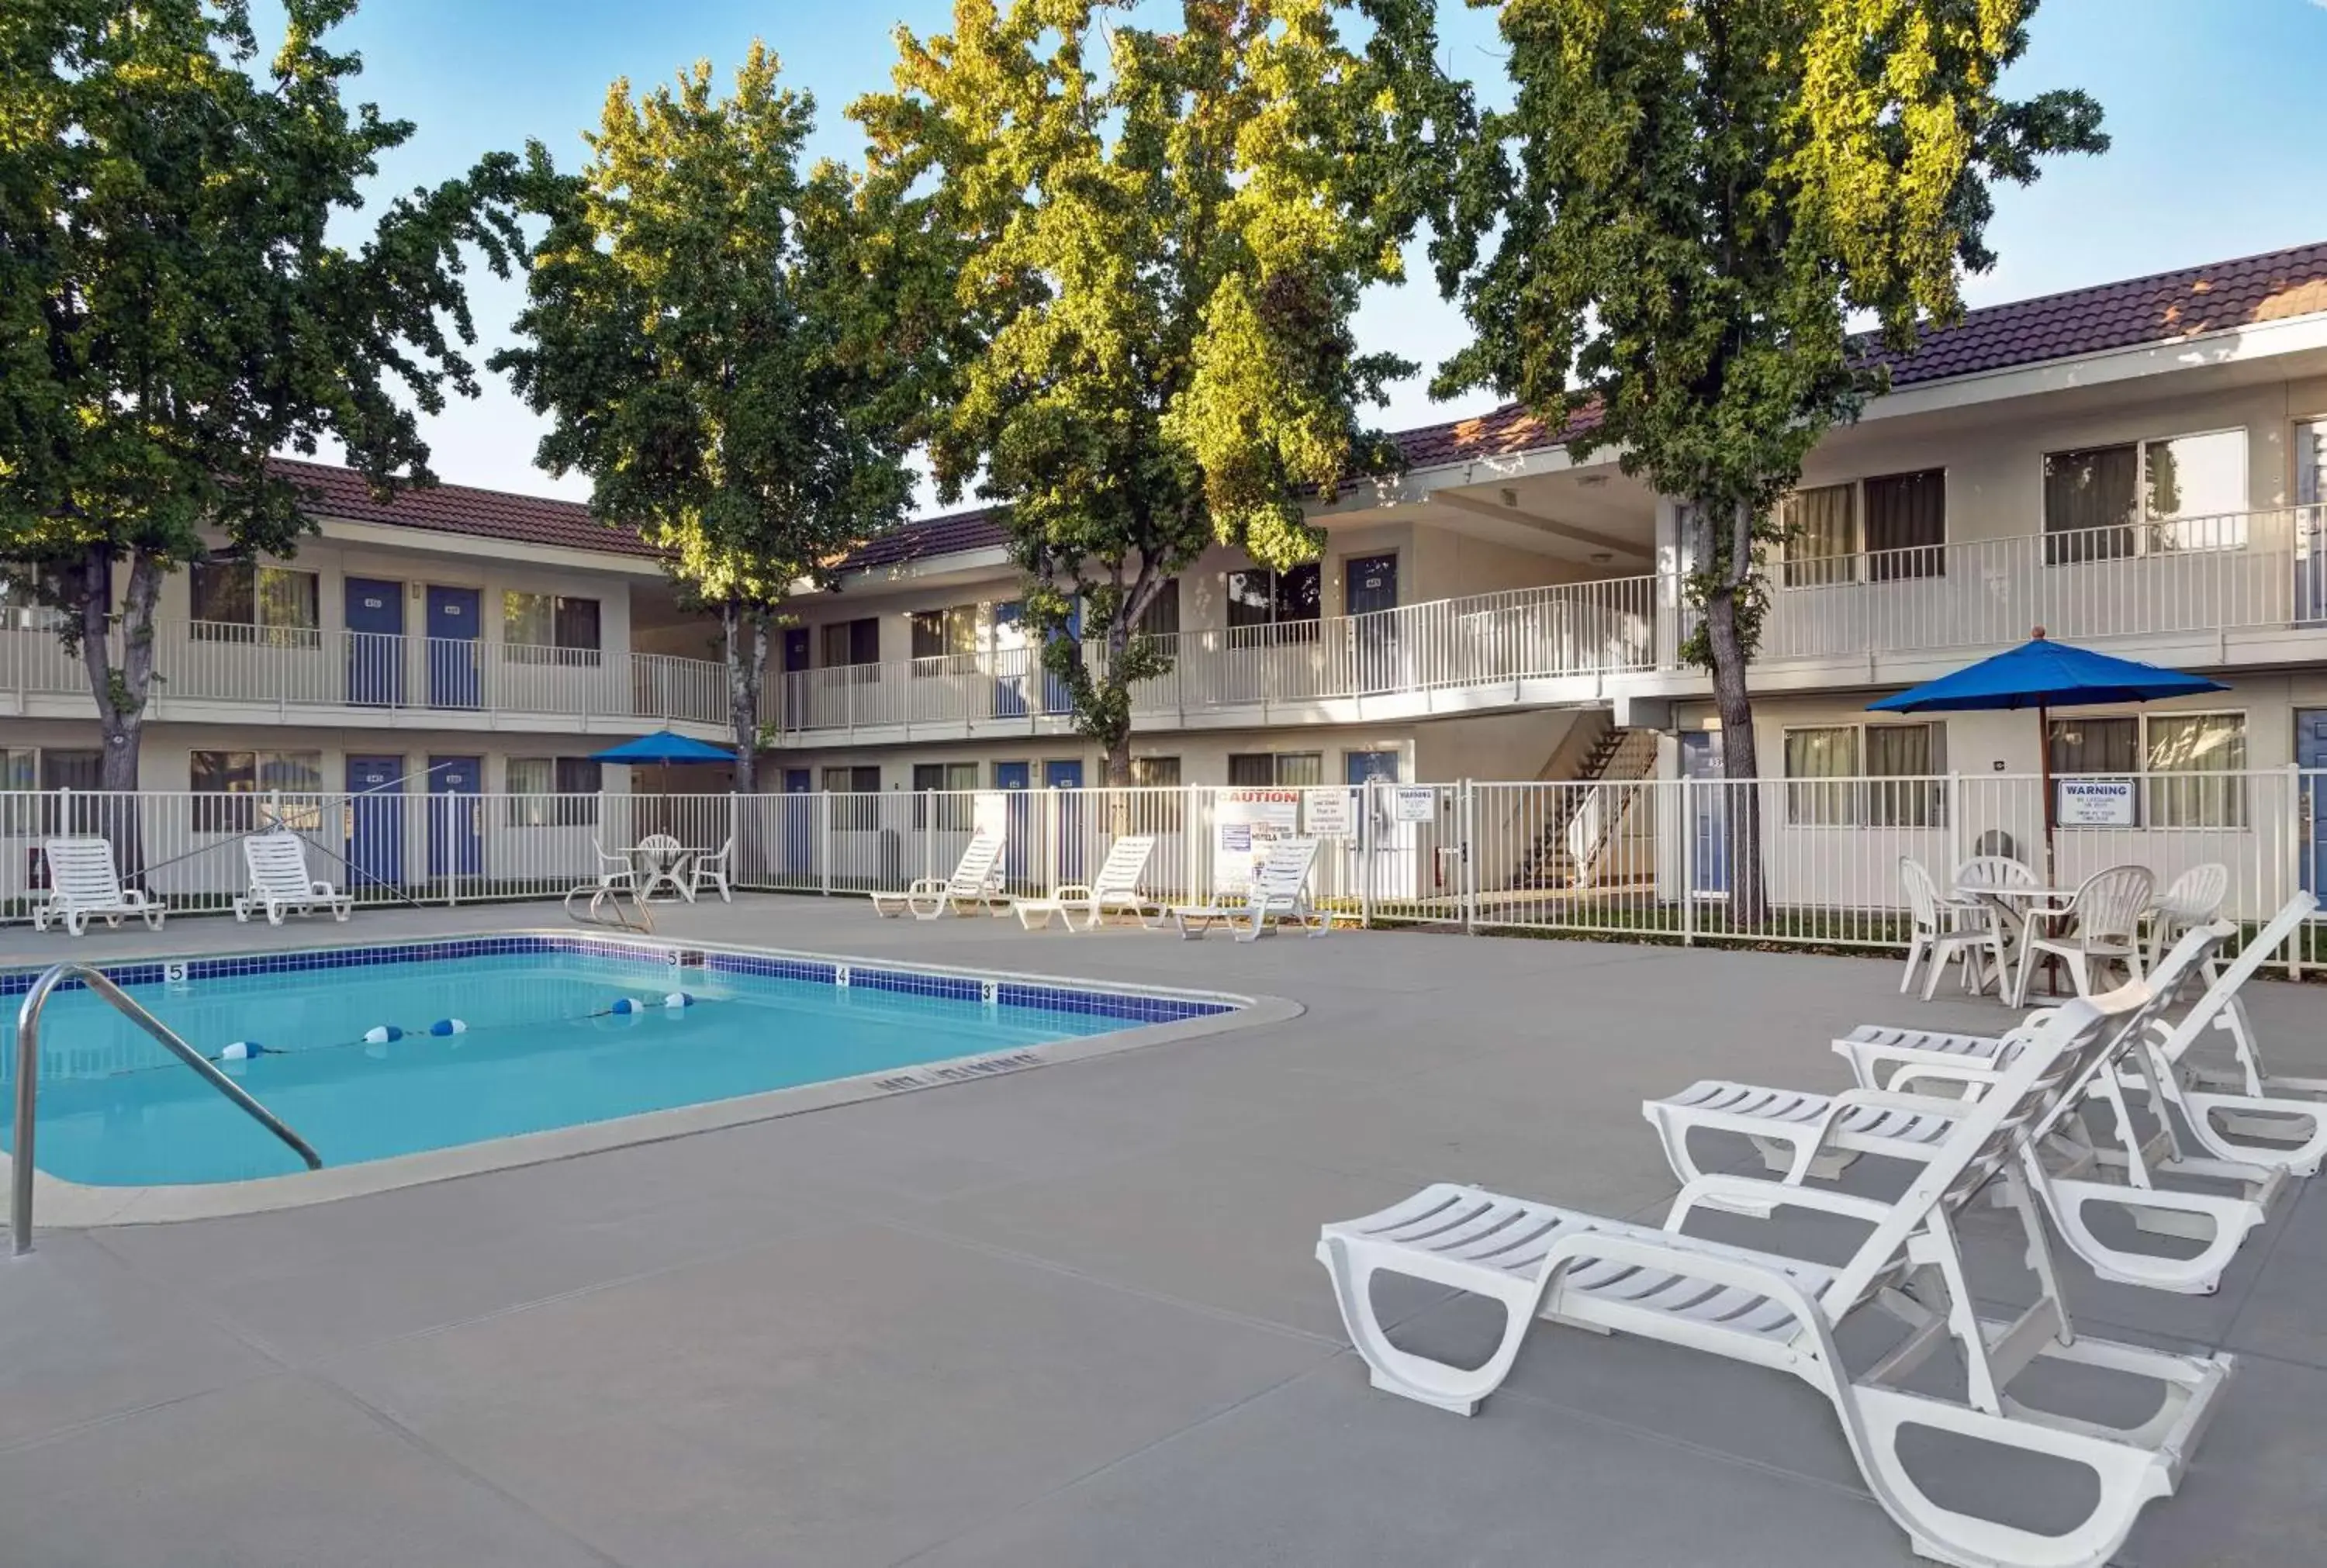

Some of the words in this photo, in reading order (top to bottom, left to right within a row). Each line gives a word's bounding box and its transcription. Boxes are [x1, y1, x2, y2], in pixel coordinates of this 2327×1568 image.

[1217, 792, 1298, 803] CAUTION
[2066, 786, 2127, 795] WARNING
[669, 950, 677, 965] 5
[171, 964, 182, 981] 5
[838, 967, 847, 984] 4
